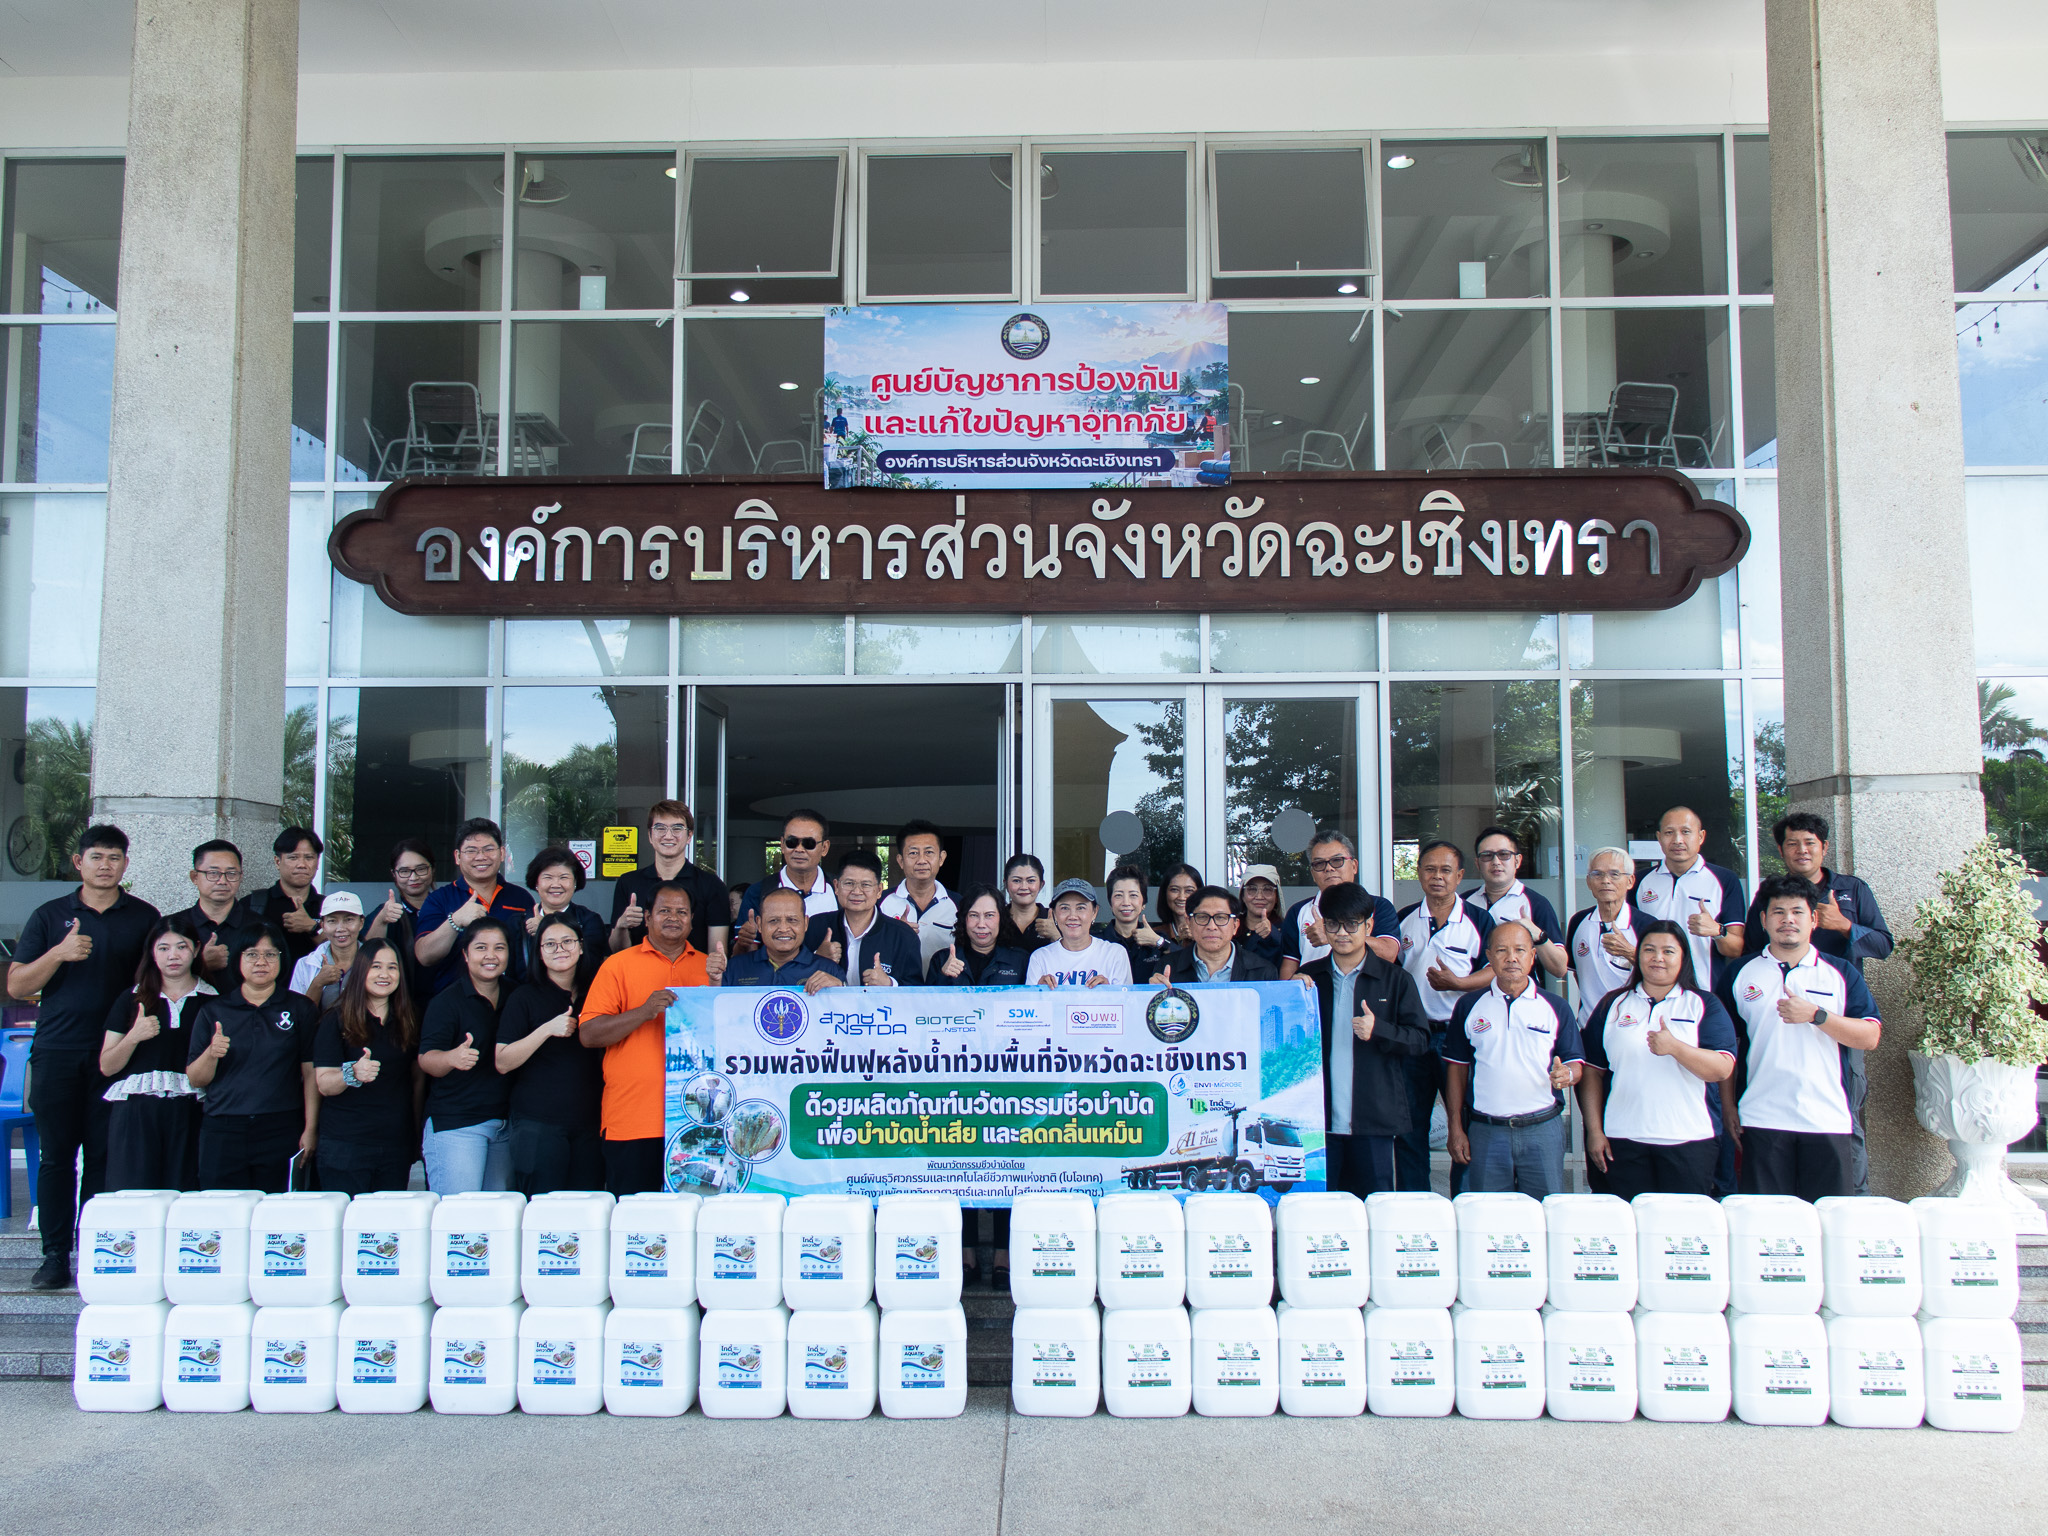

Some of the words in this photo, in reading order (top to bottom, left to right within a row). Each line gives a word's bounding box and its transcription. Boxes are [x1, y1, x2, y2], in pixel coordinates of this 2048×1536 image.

[871, 362, 1179, 401] ศูนย์บัญชาการป้องกัน
[865, 405, 1186, 440] และแก้ไขปัญหาอุทกภัย
[885, 452, 1162, 469] องค์การบริหารส่วนจังหวัดฉะเชิงเทรา
[416, 489, 1660, 581] องค์การบริหารส่วนจังหวัดฉะเชิงเทรา
[834, 1024, 907, 1036] NSTDA
[915, 1015, 976, 1025] BIOTEC
[725, 1038, 1248, 1081] รวมพลังฟื้นฟูหลังน้ำท่วมพื้นที่จังหวัดฉะเชิงเทรา
[804, 1089, 1155, 1116] ด้วยผลิตภัณฑ์นวัตกรรมชีวบำบัด
[816, 1115, 977, 1145] เพื่อบำบัดน้ำเสีย
[982, 1118, 1144, 1144] และลดกลิ่นเหม็น
[1059, 1171, 1103, 1184] (โบโอเทค)
